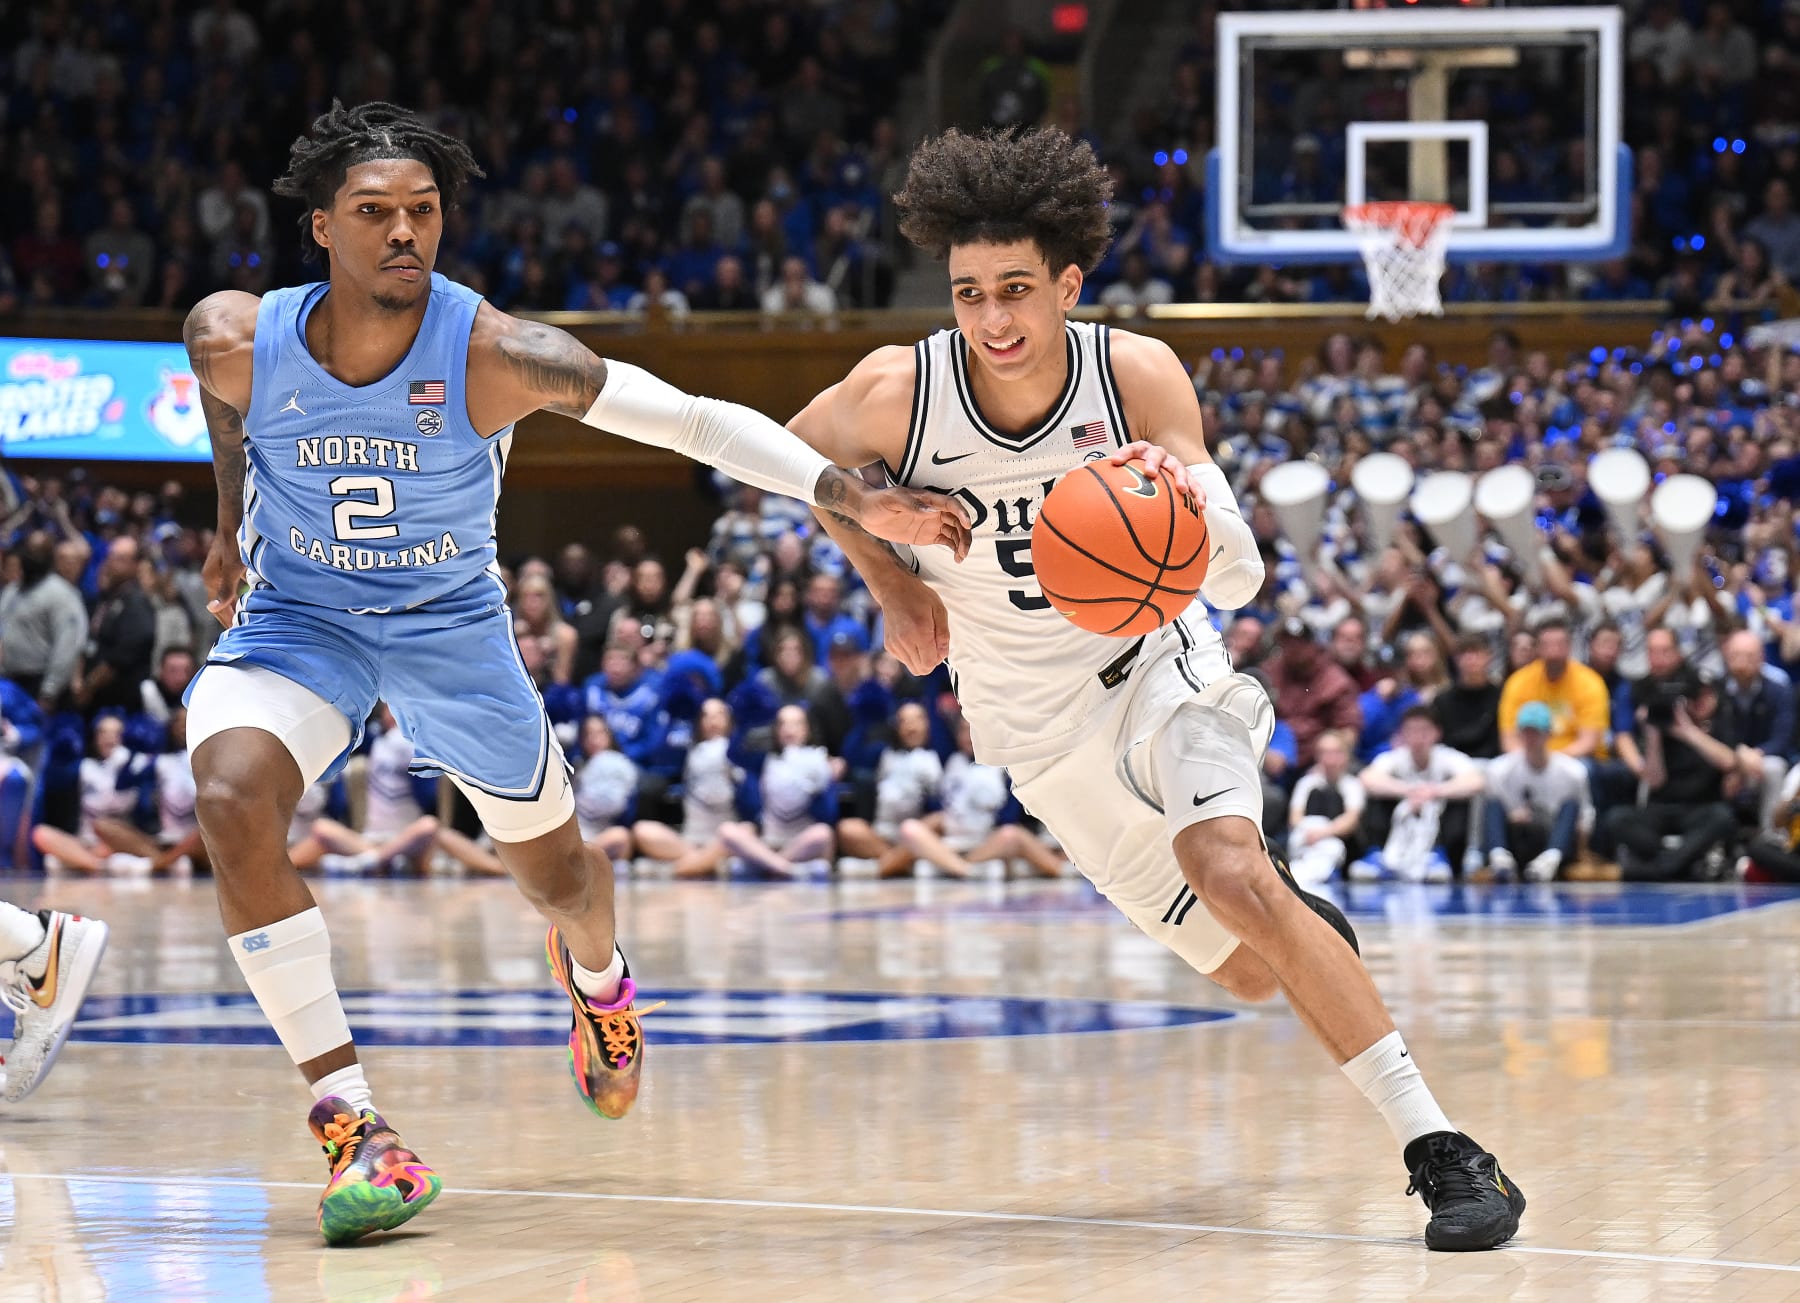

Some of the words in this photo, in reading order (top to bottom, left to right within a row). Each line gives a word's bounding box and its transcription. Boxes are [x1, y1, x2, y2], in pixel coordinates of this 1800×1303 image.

[0, 375, 114, 416] ROSTED
[297, 436, 420, 472] NORTH
[328, 476, 400, 541] 2
[923, 477, 1057, 536] Du
[289, 526, 460, 571] CAROLINA
[995, 538, 1053, 611] 5
